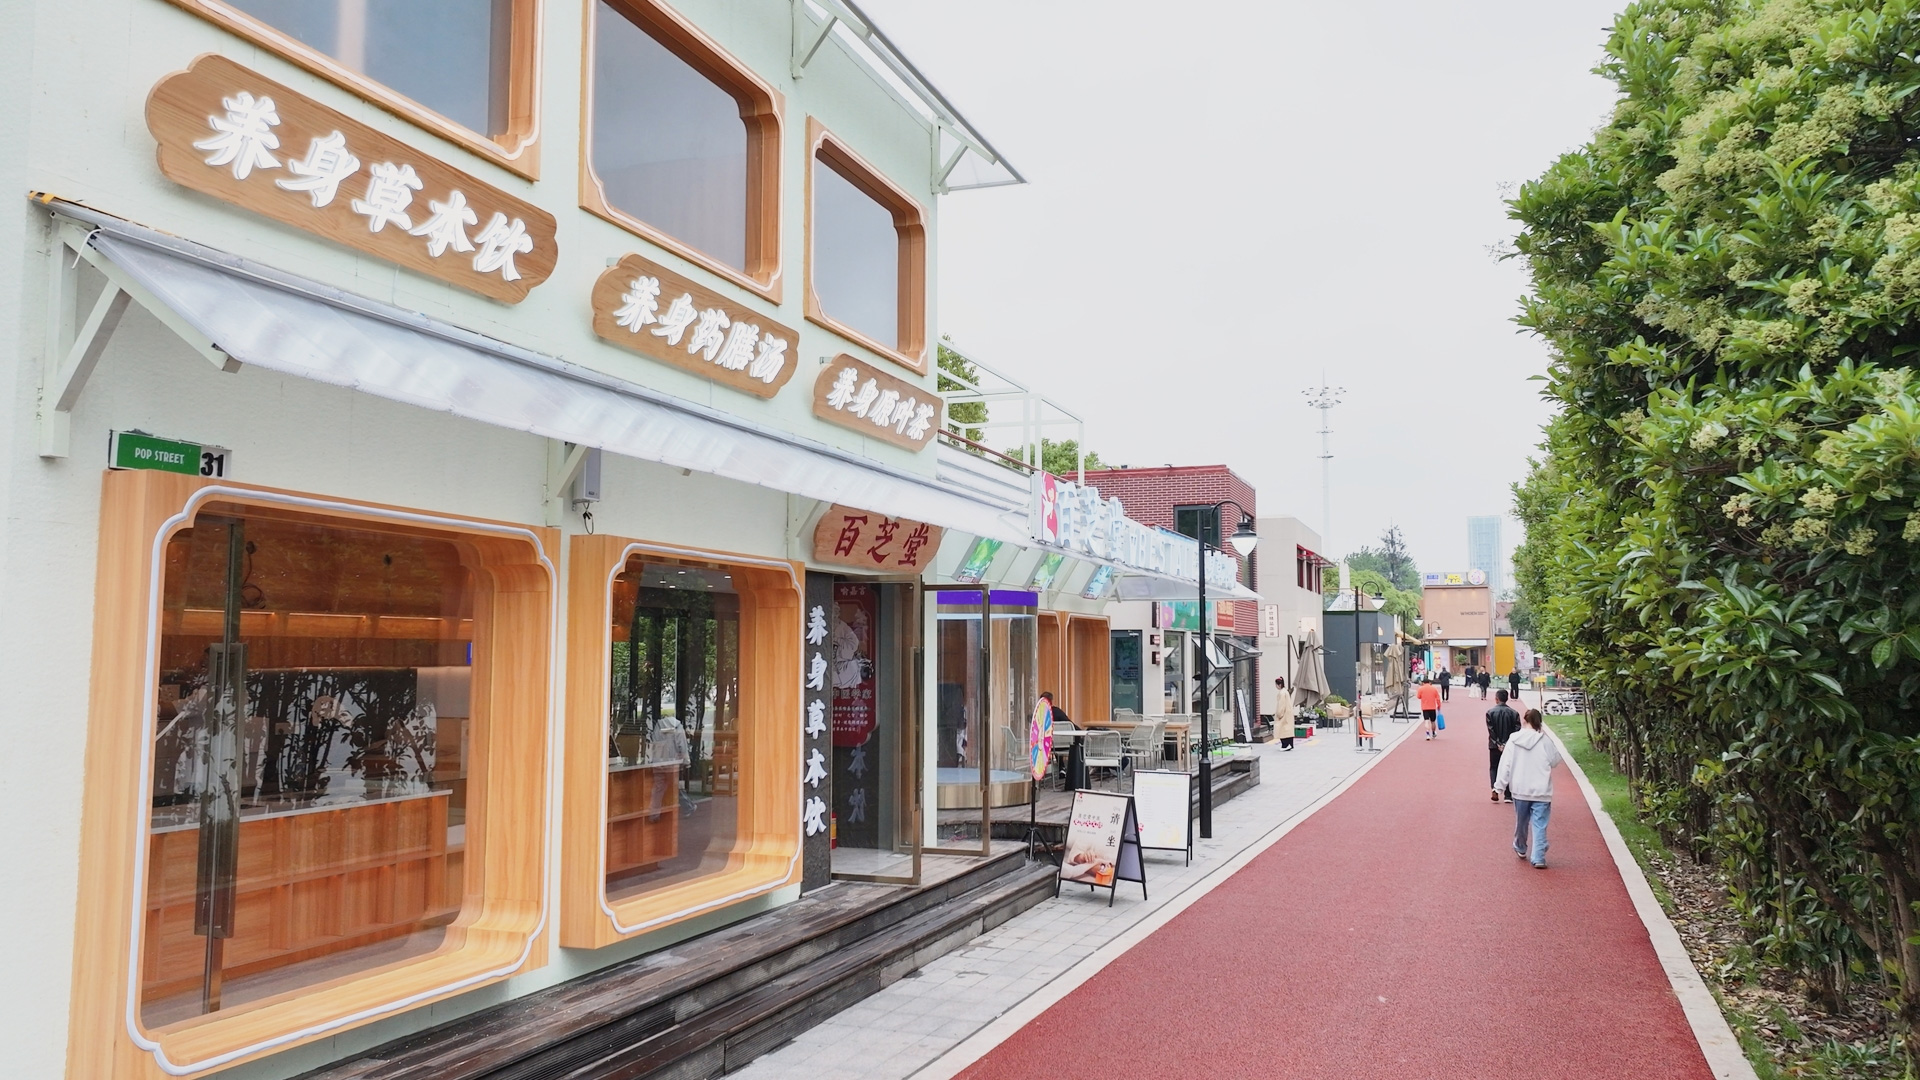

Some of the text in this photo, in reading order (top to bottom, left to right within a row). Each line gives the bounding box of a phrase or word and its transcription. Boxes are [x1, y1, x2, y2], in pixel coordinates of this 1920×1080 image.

[192, 91, 534, 282] 养身草本饮
[612, 275, 788, 384] 养身药膳汤
[826, 367, 935, 441] 养身原叶茶
[134, 447, 225, 477] POP STREET 31
[834, 514, 929, 566] 百芝堂
[804, 605, 828, 837] 养身草本饮
